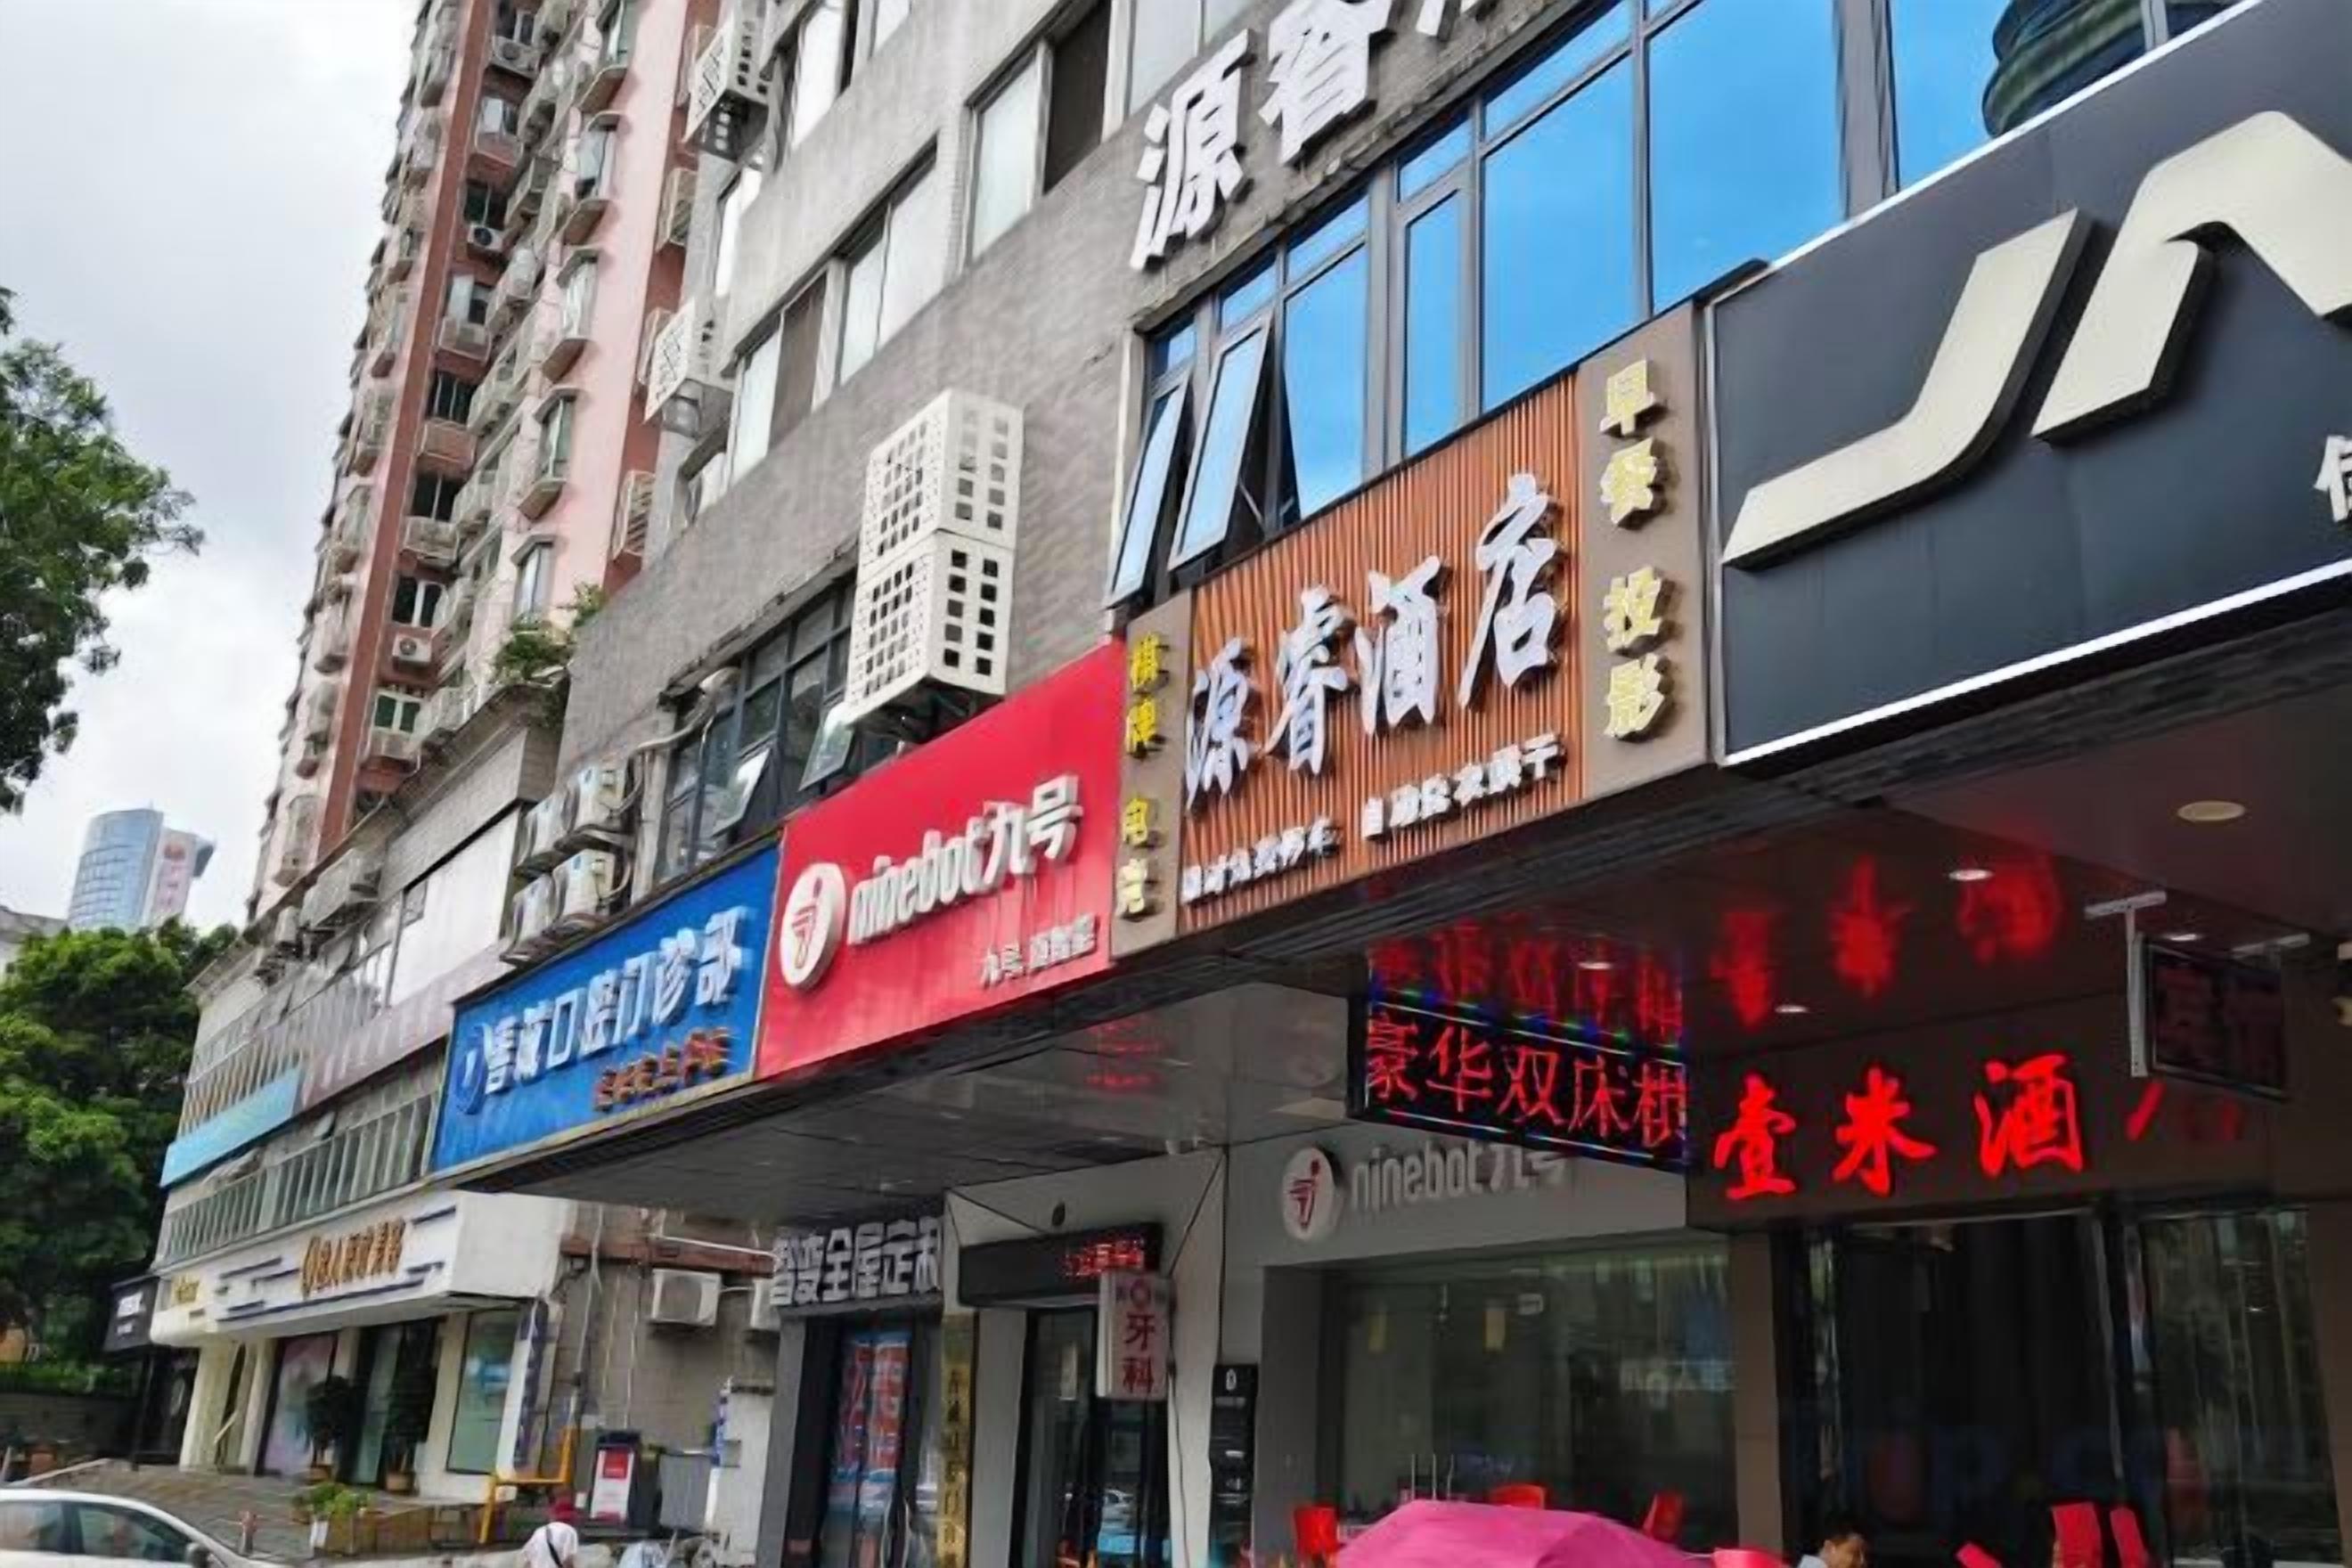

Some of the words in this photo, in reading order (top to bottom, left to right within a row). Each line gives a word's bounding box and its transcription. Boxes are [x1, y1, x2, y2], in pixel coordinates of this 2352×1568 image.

[1131, 0, 1479, 269] 源睿
[1188, 472, 1557, 811] 源睿酒店
[1713, 1053, 2165, 1200] 壹米酒
[1123, 1311, 1156, 1394] 牙科
